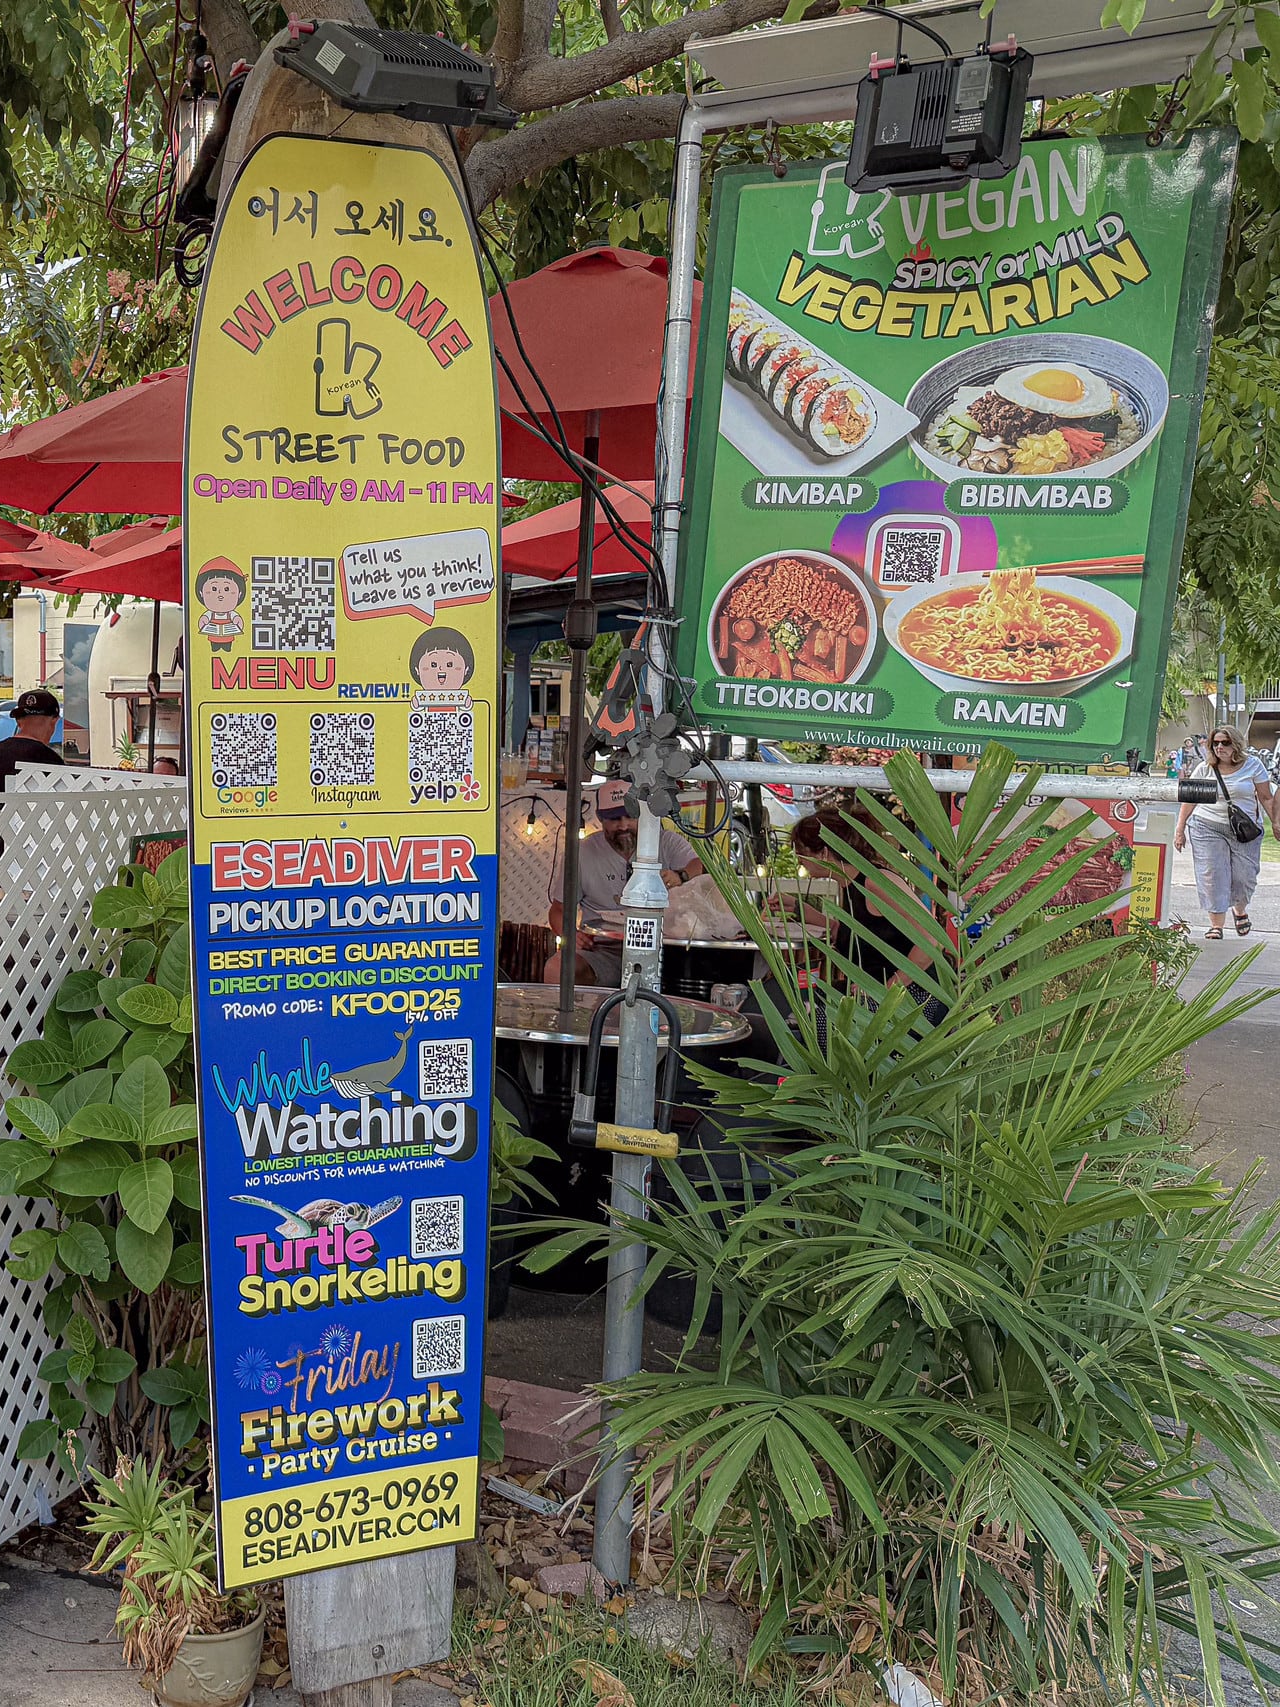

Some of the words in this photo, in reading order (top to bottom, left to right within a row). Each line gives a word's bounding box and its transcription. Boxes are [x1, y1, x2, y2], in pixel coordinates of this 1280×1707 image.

[248, 186, 318, 239] 어서
[334, 198, 453, 248] 오세요.
[901, 146, 1088, 246] VEGAN
[893, 256, 993, 290] SPICY
[996, 253, 1027, 279] or
[1036, 213, 1126, 269] MILD
[776, 237, 1151, 340] VEGETARIAN
[220, 256, 473, 369] WELCOME
[222, 425, 365, 465] STREET
[378, 434, 466, 468] FOOD
[193, 473, 267, 503] Open
[272, 476, 337, 506] Daily
[340, 478, 357, 500] 9
[361, 480, 404, 503] AM
[425, 481, 449, 504] 11
[452, 482, 494, 505] PM
[754, 482, 864, 508] KIMBAP
[960, 483, 1113, 510] BIBIMBAB
[348, 549, 378, 566] Tell
[384, 549, 402, 563] us
[349, 569, 393, 586] what
[397, 565, 427, 588] you
[432, 555, 482, 577] think!
[352, 586, 397, 606] Leave
[404, 587, 421, 600] us
[426, 585, 436, 596] a
[441, 577, 496, 593] review
[211, 656, 336, 691] MENU
[337, 683, 400, 699] REVIEW
[715, 683, 875, 717] TTEOKBOKKI
[952, 697, 1067, 728] RAMEN
[804, 727, 982, 755] www.kfoodhawaii.com
[217, 786, 278, 808] Google
[310, 786, 382, 808] Instagram
[410, 781, 458, 804] yelp
[220, 806, 250, 815] Reviews
[211, 835, 479, 891] ESEADIVER
[209, 899, 326, 934] PICKUP
[329, 892, 480, 928] LOCATION
[209, 949, 268, 971] BEST
[271, 945, 337, 967] PRICE
[344, 938, 480, 962] GUARANTEE
[209, 974, 283, 996] DIRECT
[286, 968, 377, 992] BOOKING
[380, 963, 484, 985] DISCOUNT
[222, 1002, 277, 1020] PROMO
[282, 999, 324, 1015] CODE:
[331, 988, 462, 1018] KFOOD25
[404, 1010, 429, 1024] 15%
[434, 1009, 459, 1022] OFF
[212, 1038, 333, 1113] Whale
[235, 1091, 466, 1158] Watching
[623, 1140, 659, 1149] KRYPTONITE
[244, 1155, 304, 1174] LOWEST
[304, 1152, 345, 1167] PRICE
[347, 1144, 434, 1164] GUARANTEE!
[245, 1177, 260, 1188] NO
[264, 1169, 320, 1185] DISCOUNTS
[324, 1167, 345, 1178] FOR
[347, 1163, 386, 1176] WHALE
[389, 1157, 446, 1172] WATCHING
[235, 1223, 378, 1276] Turtle
[238, 1255, 462, 1314] Snorkeling
[275, 1331, 400, 1414] Friday
[240, 1382, 459, 1457] Firework
[262, 1442, 340, 1479] Party
[345, 1430, 439, 1463] Cruise
[244, 1471, 459, 1538] 808-673-0969
[242, 1503, 460, 1569] ESEADIVER.COM
